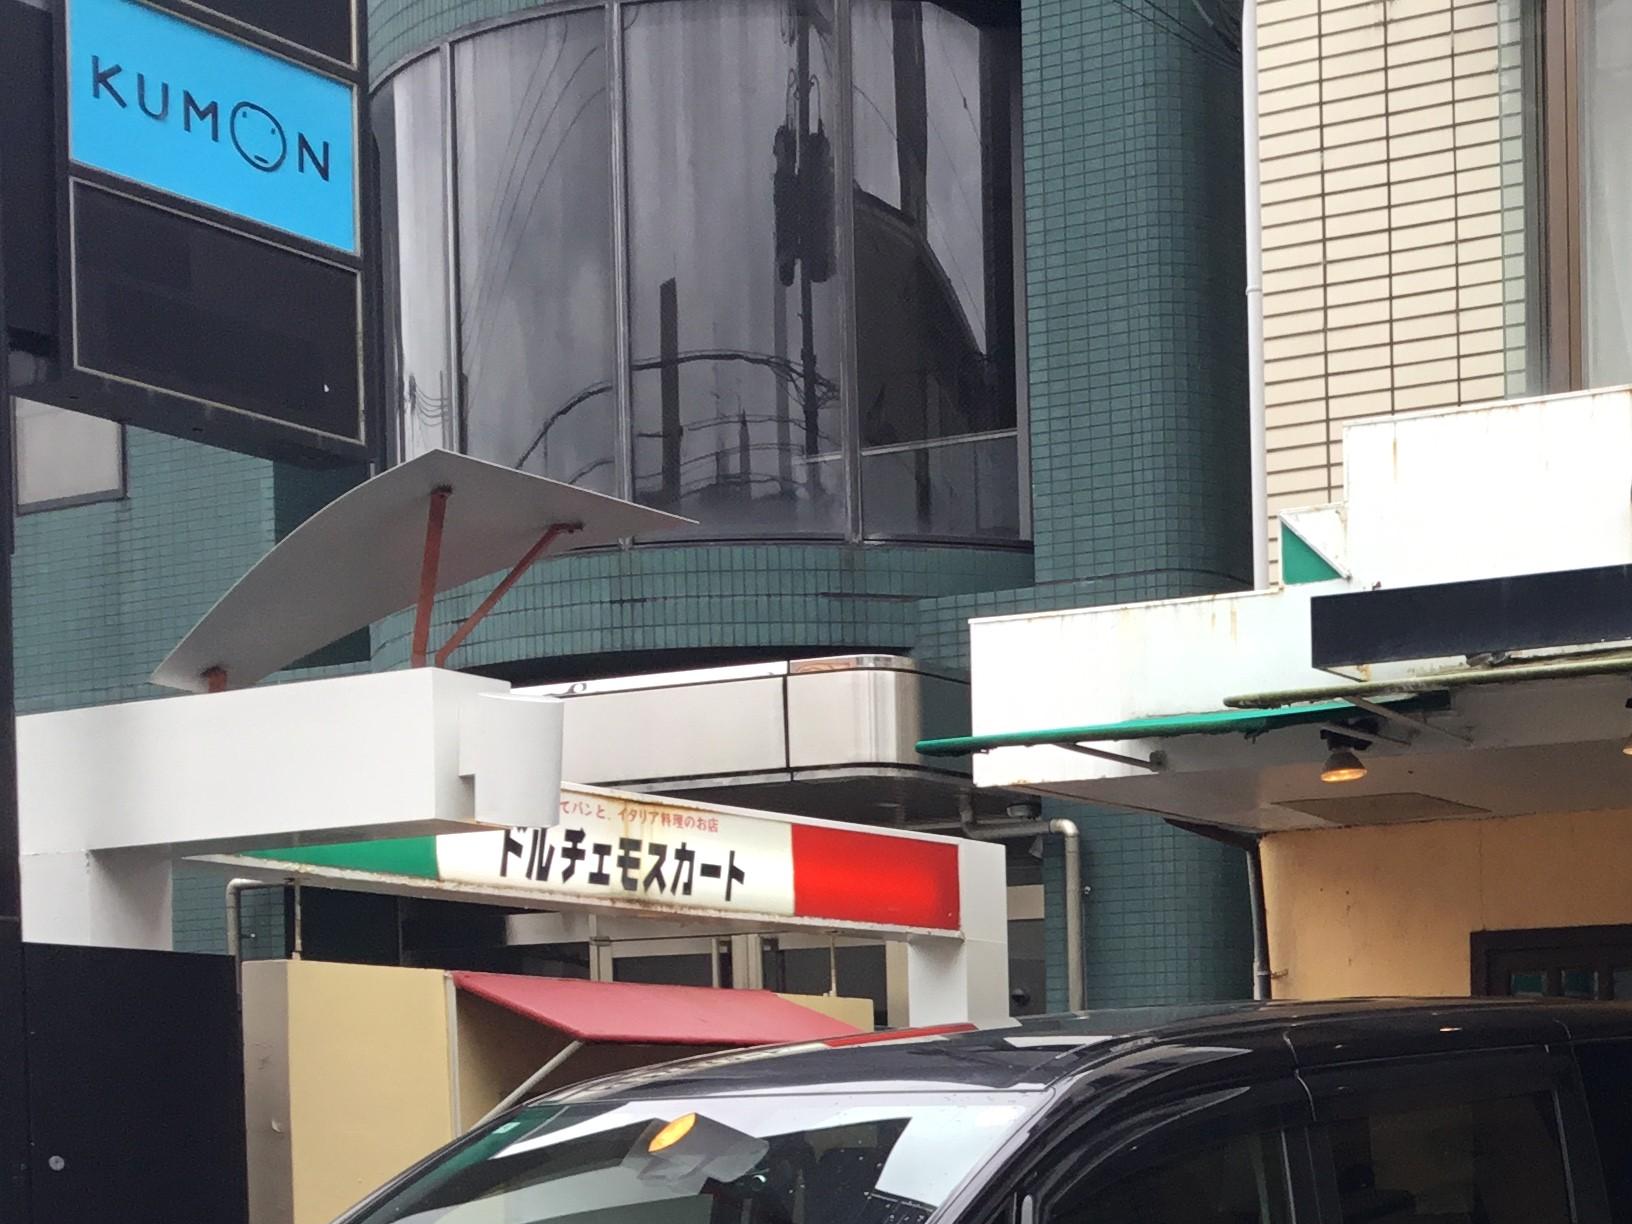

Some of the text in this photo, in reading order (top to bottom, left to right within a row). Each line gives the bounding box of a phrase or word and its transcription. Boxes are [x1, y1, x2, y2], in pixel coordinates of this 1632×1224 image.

[91, 54, 331, 184] KUMON
[498, 825, 746, 902] ドルチェモスカート
